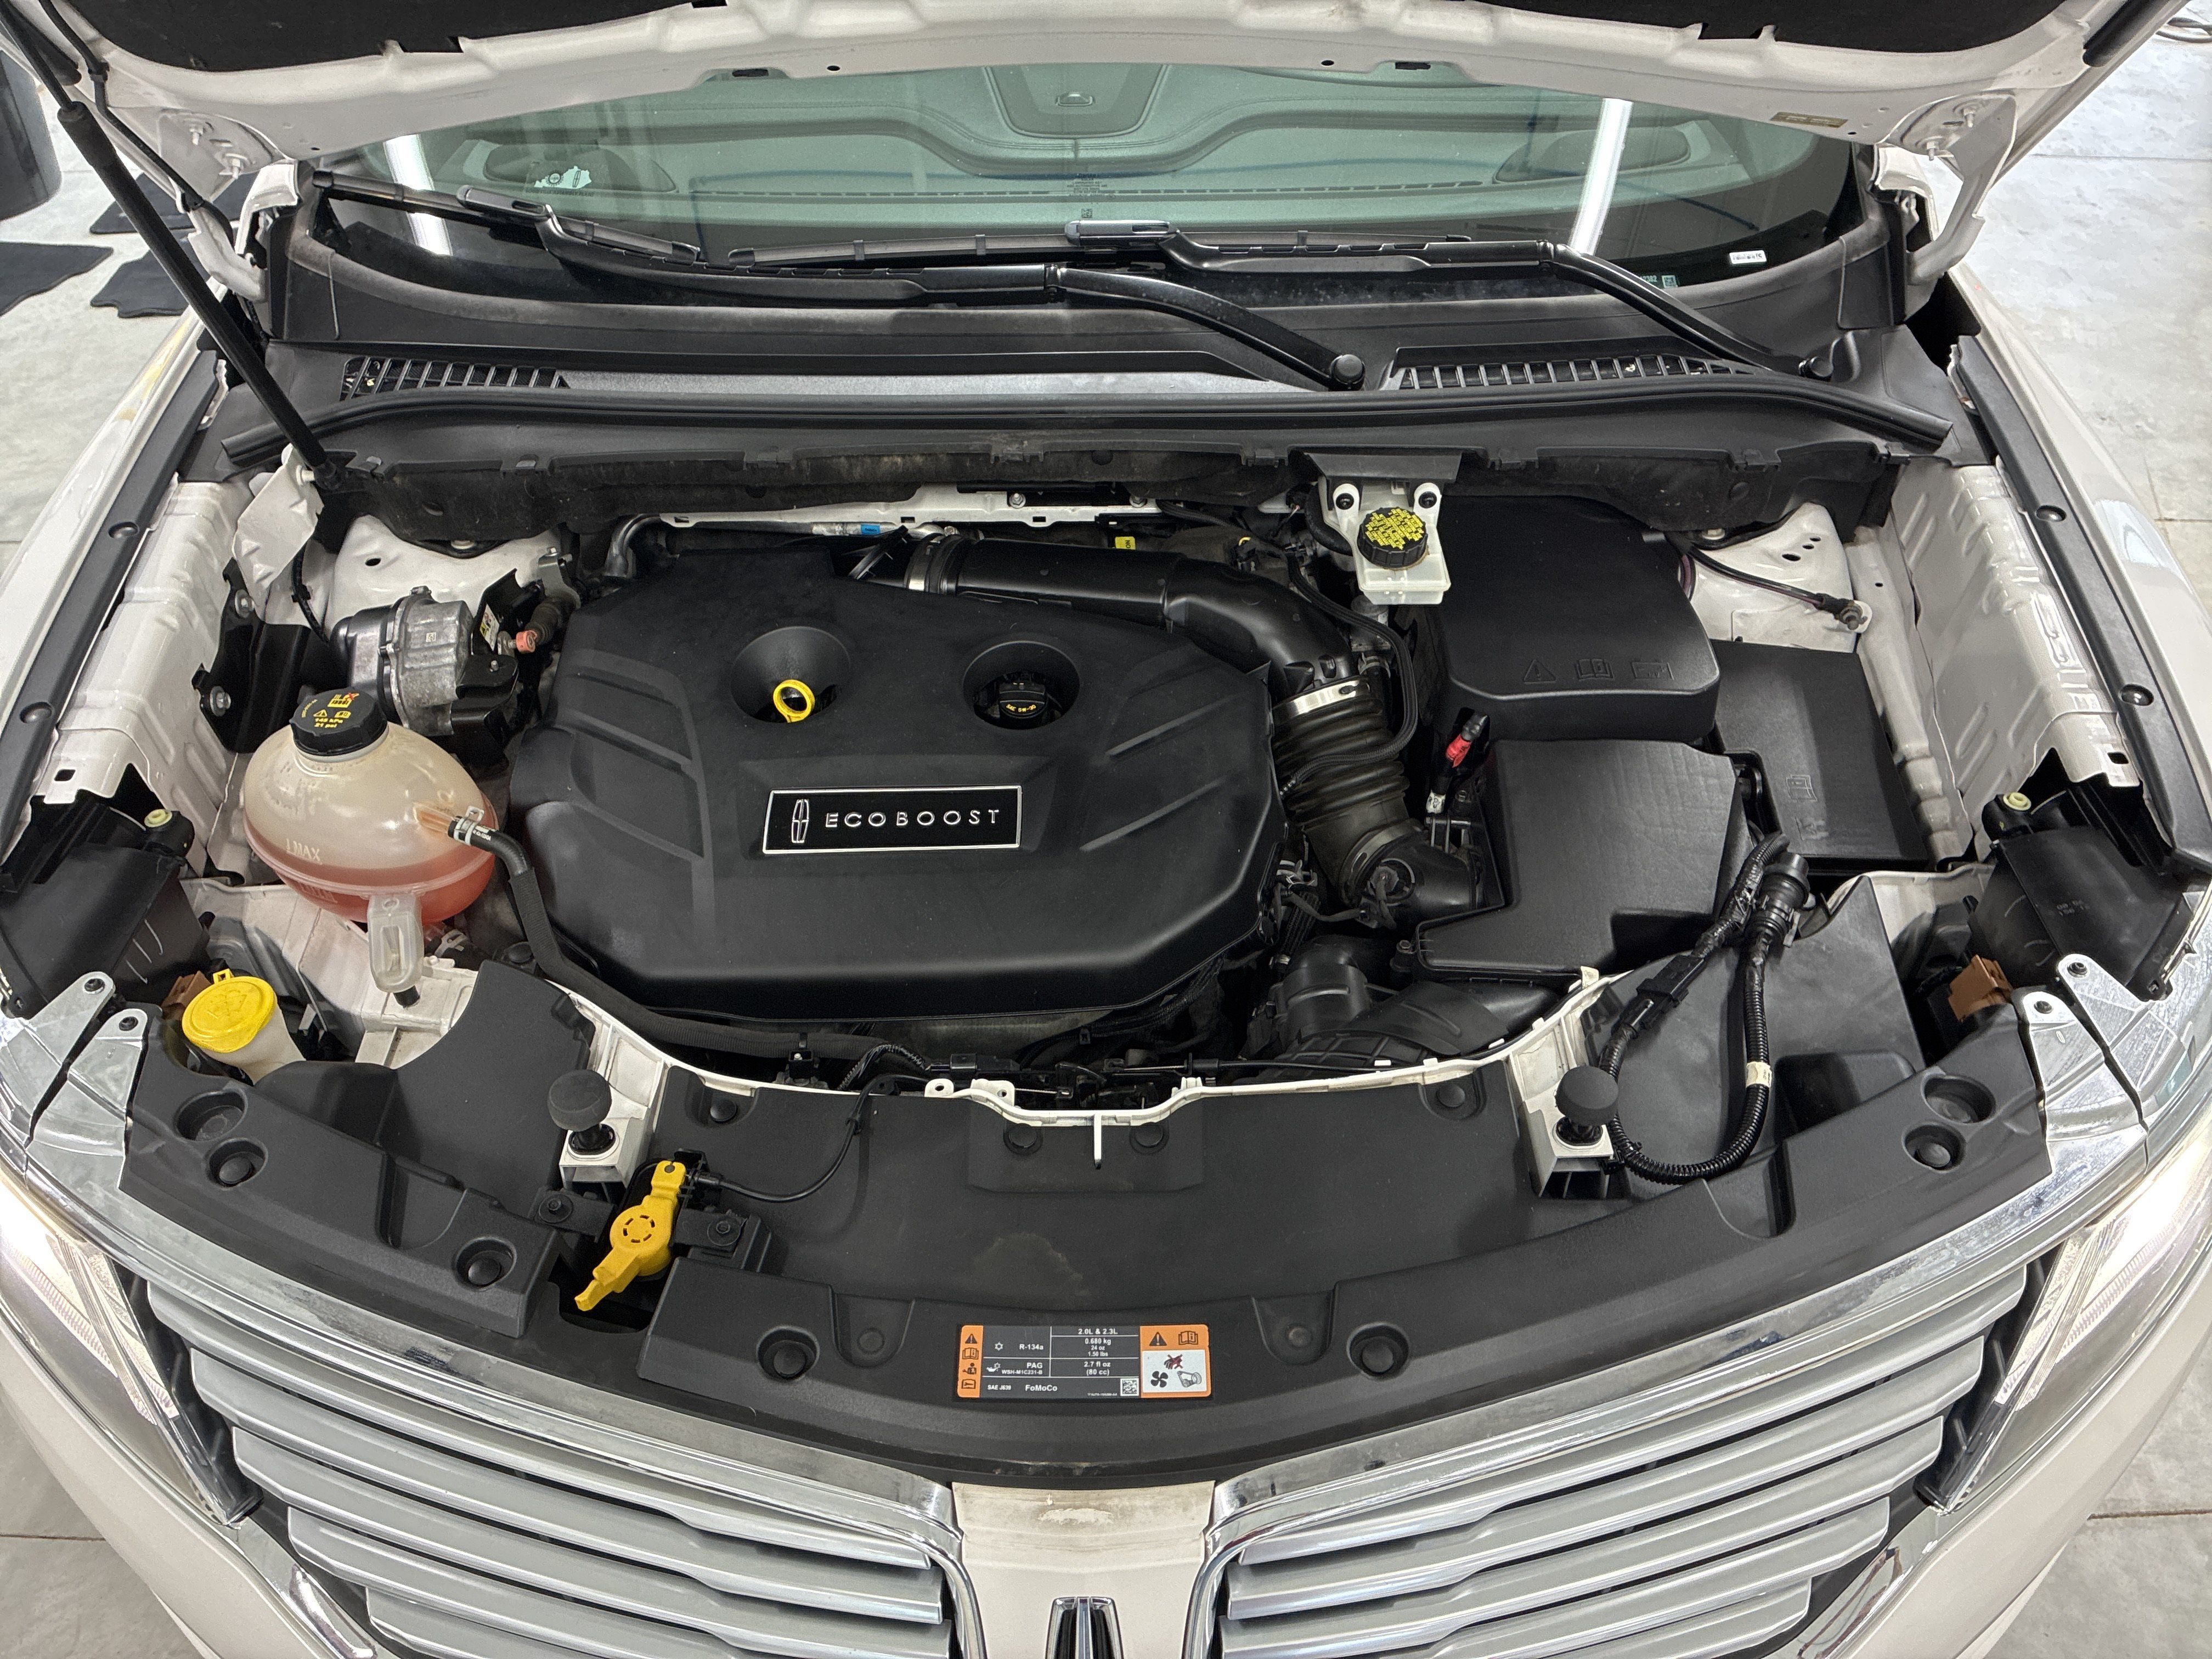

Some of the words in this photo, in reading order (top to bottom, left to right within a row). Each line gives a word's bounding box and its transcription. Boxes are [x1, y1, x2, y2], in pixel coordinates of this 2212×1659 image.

[1103, 1338, 1111, 1346] kg
[1086, 1368, 1097, 1376] (80
[1098, 1368, 1110, 1376] cc)
